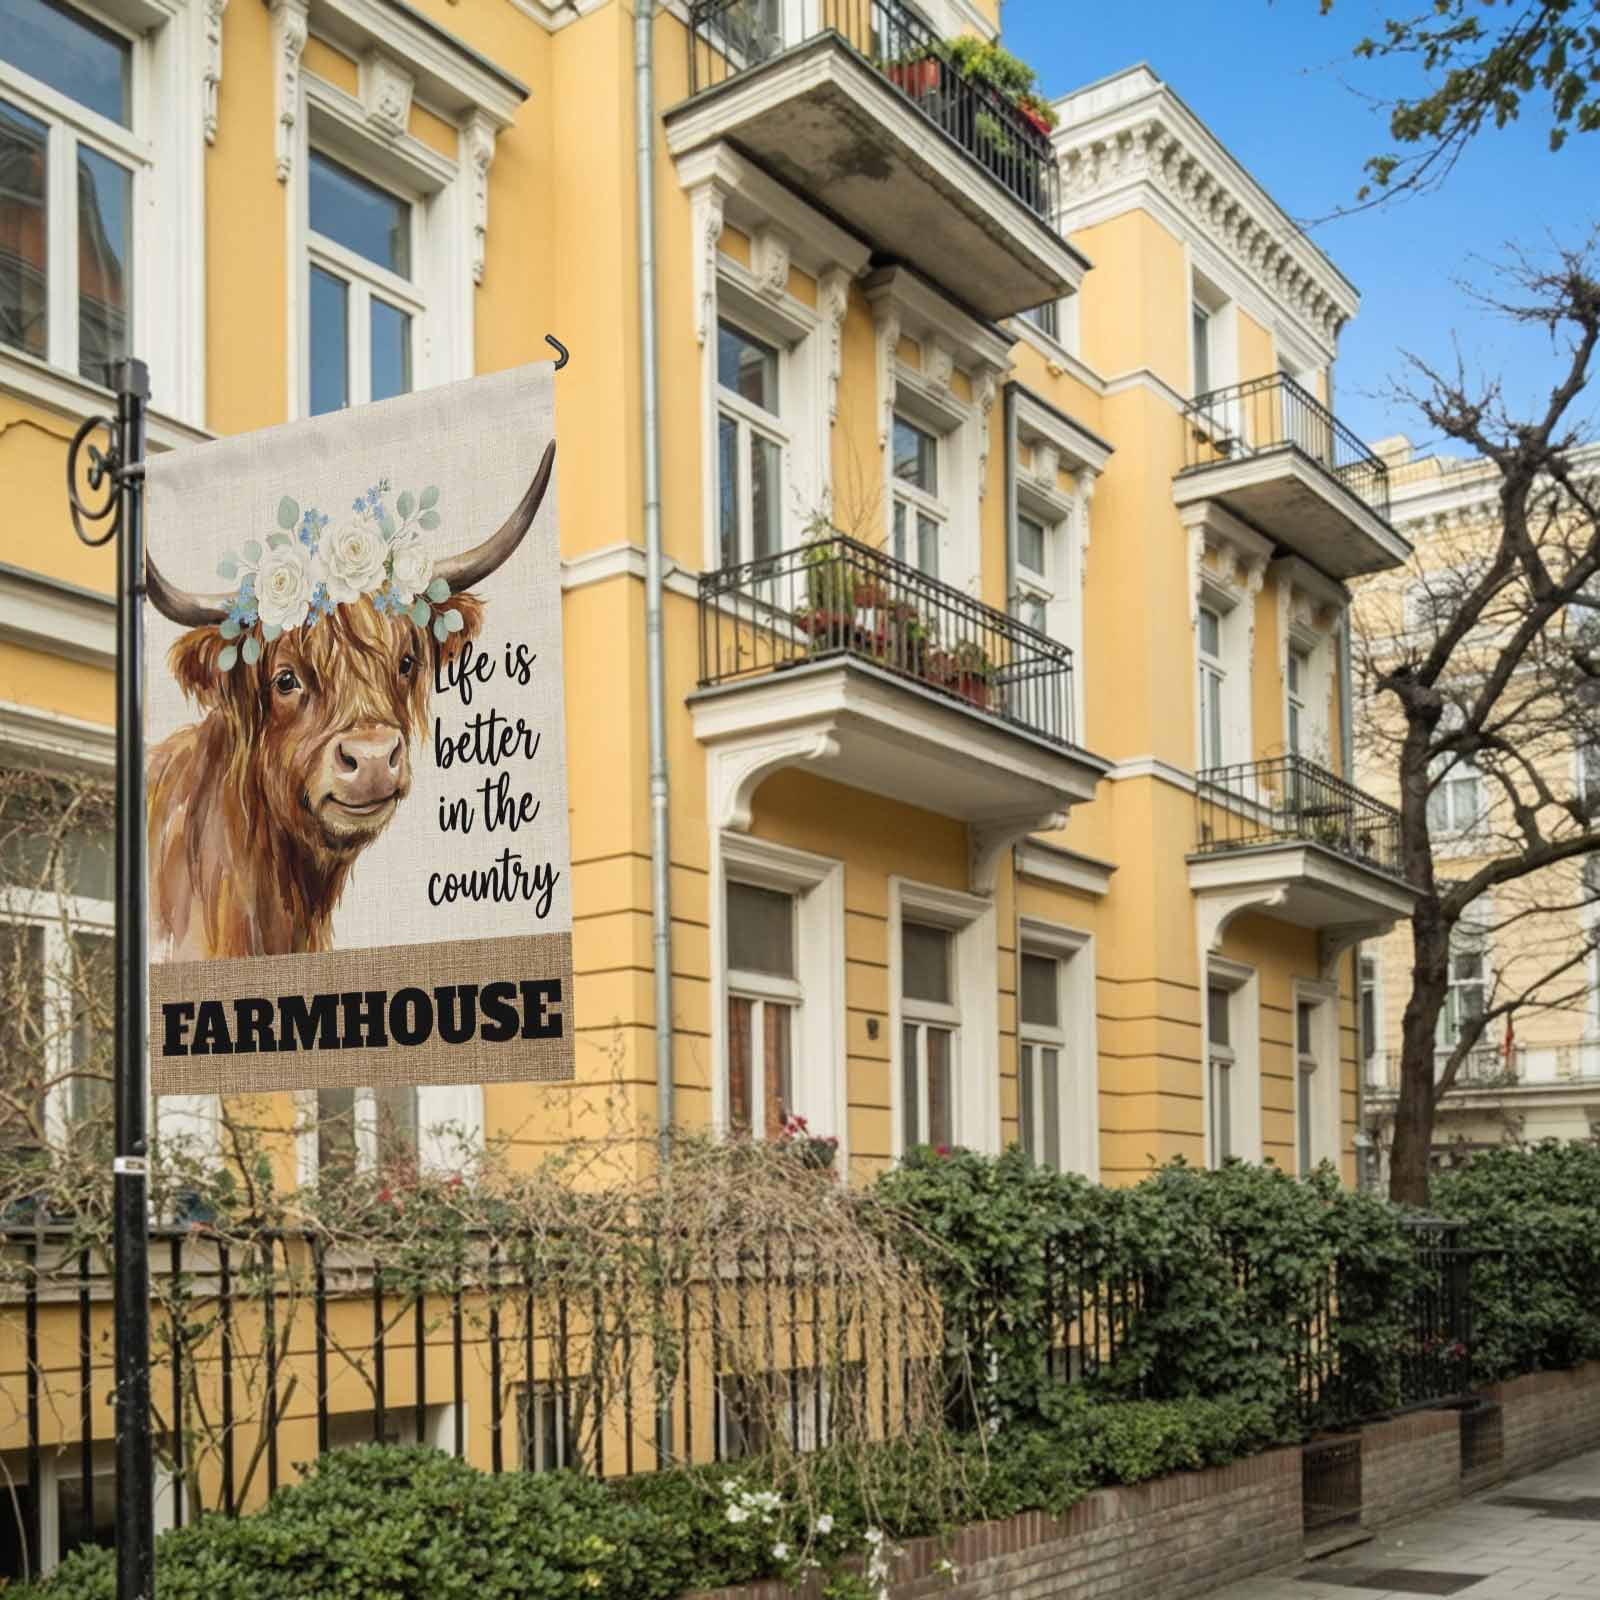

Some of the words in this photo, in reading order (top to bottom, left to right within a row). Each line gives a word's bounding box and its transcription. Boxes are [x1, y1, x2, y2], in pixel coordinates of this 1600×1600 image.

[434, 641, 496, 705] Life
[505, 642, 537, 685] is
[434, 708, 540, 769] better
[439, 796, 474, 834] in
[476, 771, 540, 832] the
[428, 848, 560, 919] country
[162, 978, 563, 1056] FARMHOUSE
